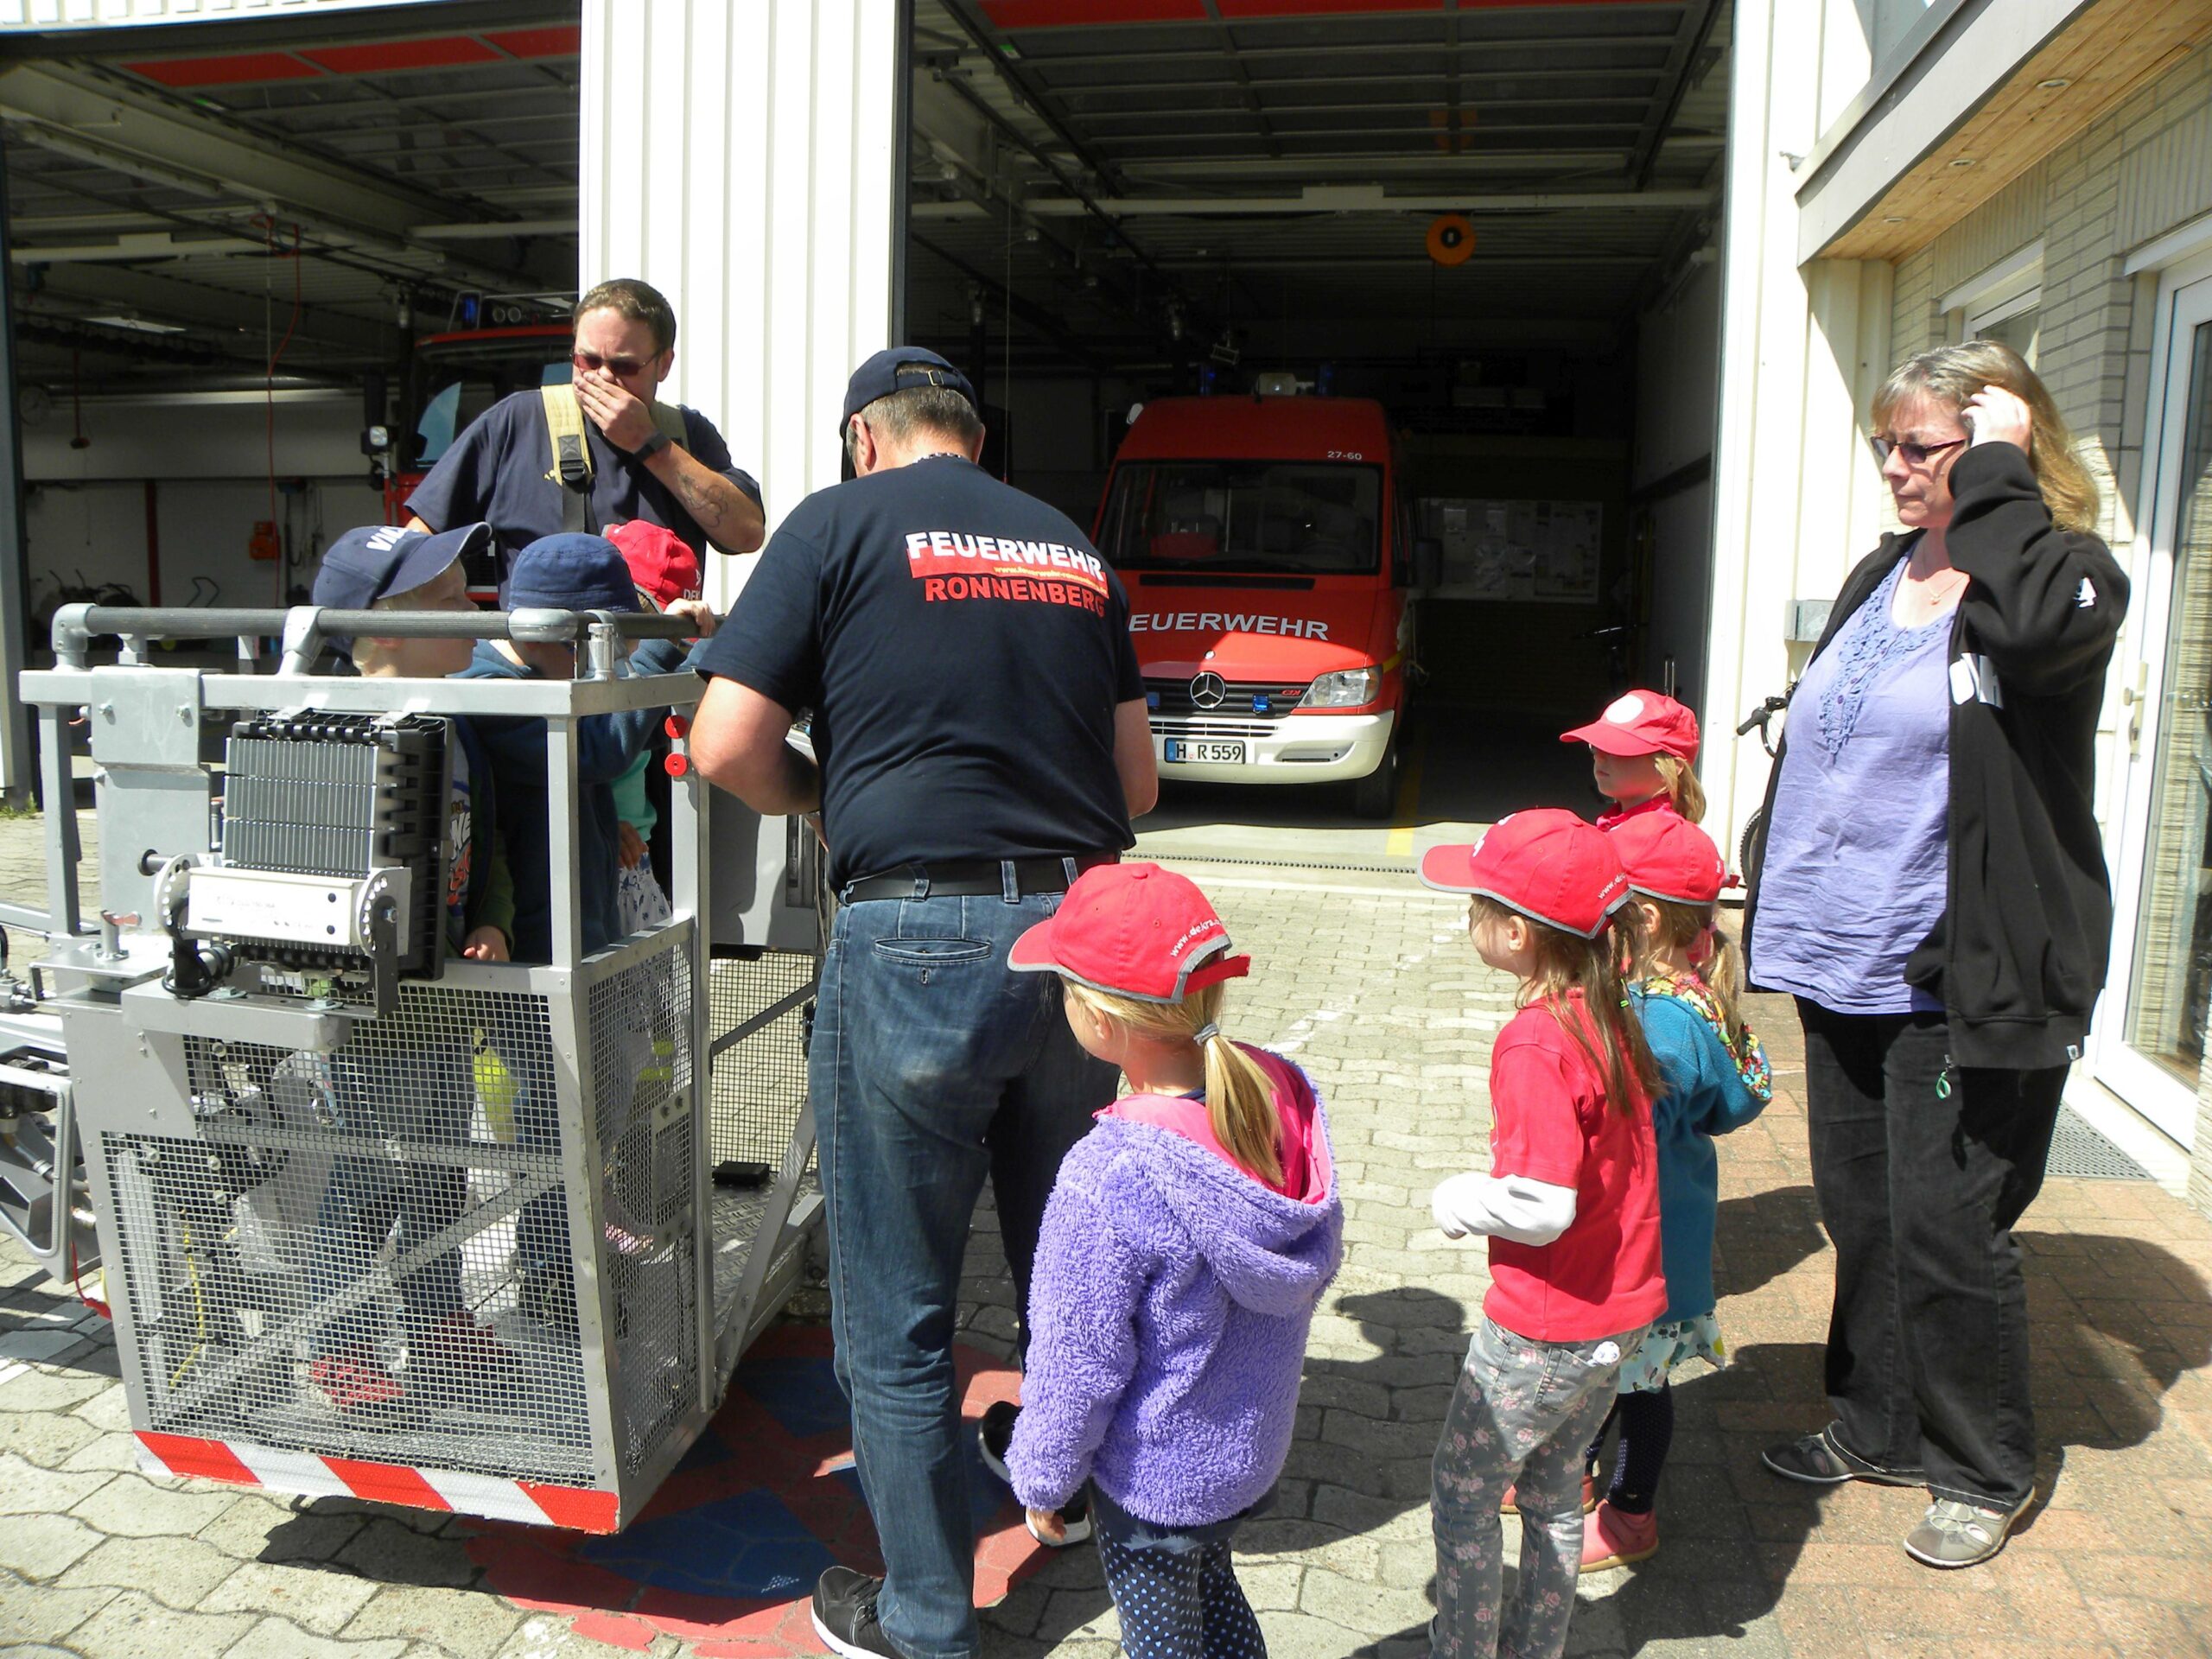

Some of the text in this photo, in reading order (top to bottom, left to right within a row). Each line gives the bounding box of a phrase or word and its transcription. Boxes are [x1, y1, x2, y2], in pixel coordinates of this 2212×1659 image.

[1327, 450, 1363, 461] 27-60
[905, 531, 1105, 582] FEUERWEHR
[925, 576, 1105, 618] RONNENBERG
[1128, 612, 1330, 641] EUERWEHR
[1176, 743, 1186, 759] H
[1198, 744, 1208, 760] R
[1211, 745, 1242, 760] 559
